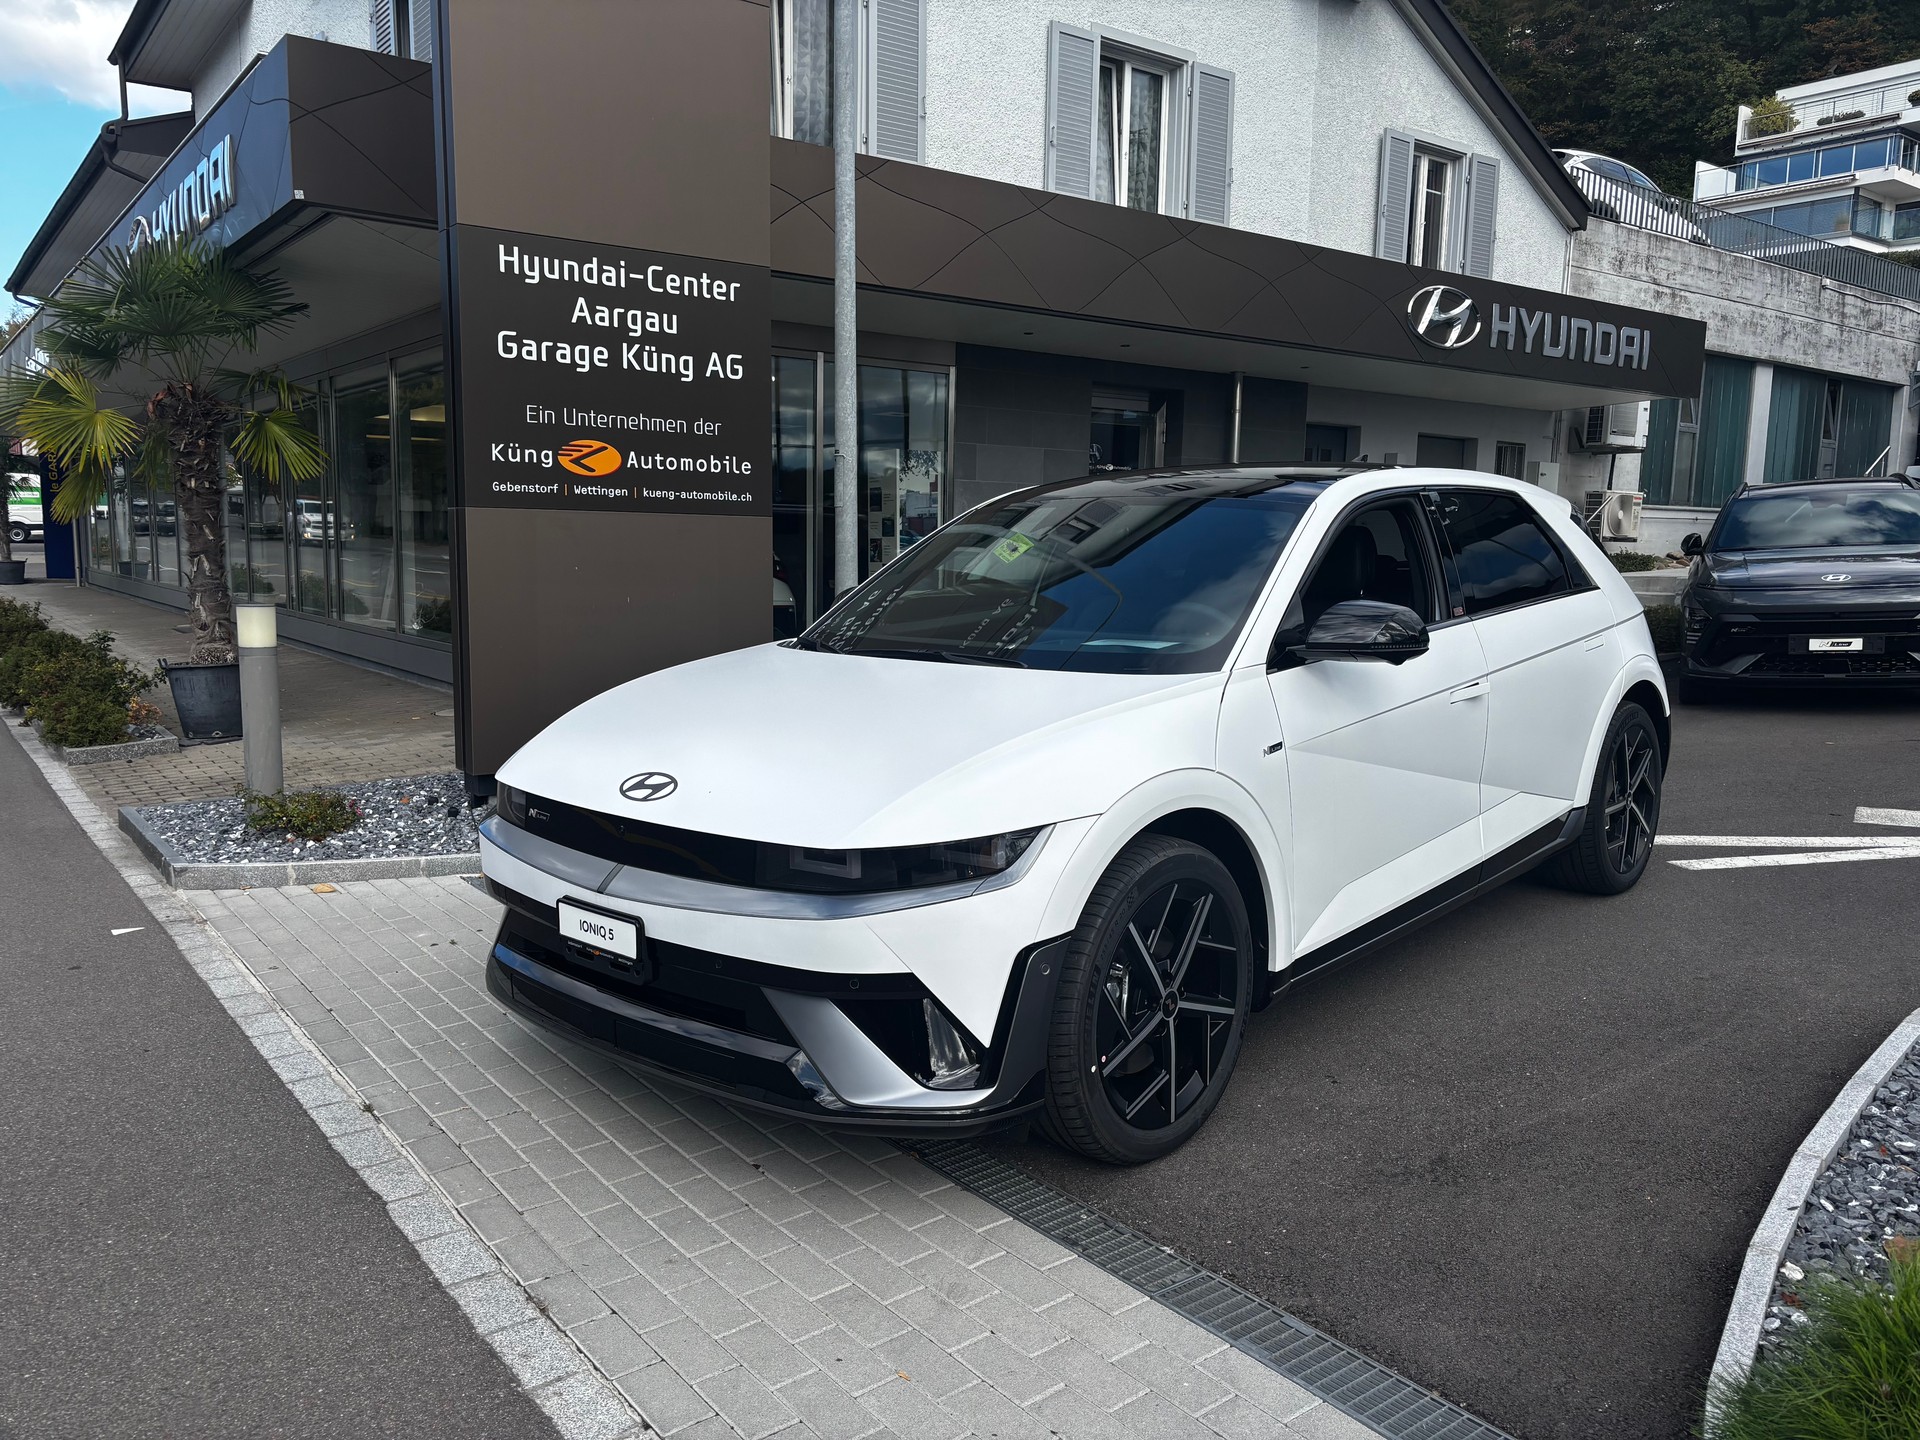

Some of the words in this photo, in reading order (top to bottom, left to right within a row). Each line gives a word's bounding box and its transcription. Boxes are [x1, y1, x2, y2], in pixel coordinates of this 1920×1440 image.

[498, 244, 741, 302] Hyundai-Center
[571, 296, 678, 337] Aargau
[1489, 303, 1650, 370] HYUNDAI
[497, 330, 609, 373] Garage
[622, 342, 694, 382] Küng
[705, 352, 744, 380] AG
[526, 404, 555, 425] Ein
[563, 407, 687, 433] Unternehmen
[693, 417, 722, 436] der
[491, 443, 554, 468] Küng
[627, 451, 752, 475] Automobile
[492, 481, 559, 494] Gebenstorf
[573, 485, 628, 498] Wettingen
[643, 488, 752, 502] kueng-automobile.ch
[580, 919, 607, 941] IONIQ
[608, 928, 615, 941] 5
